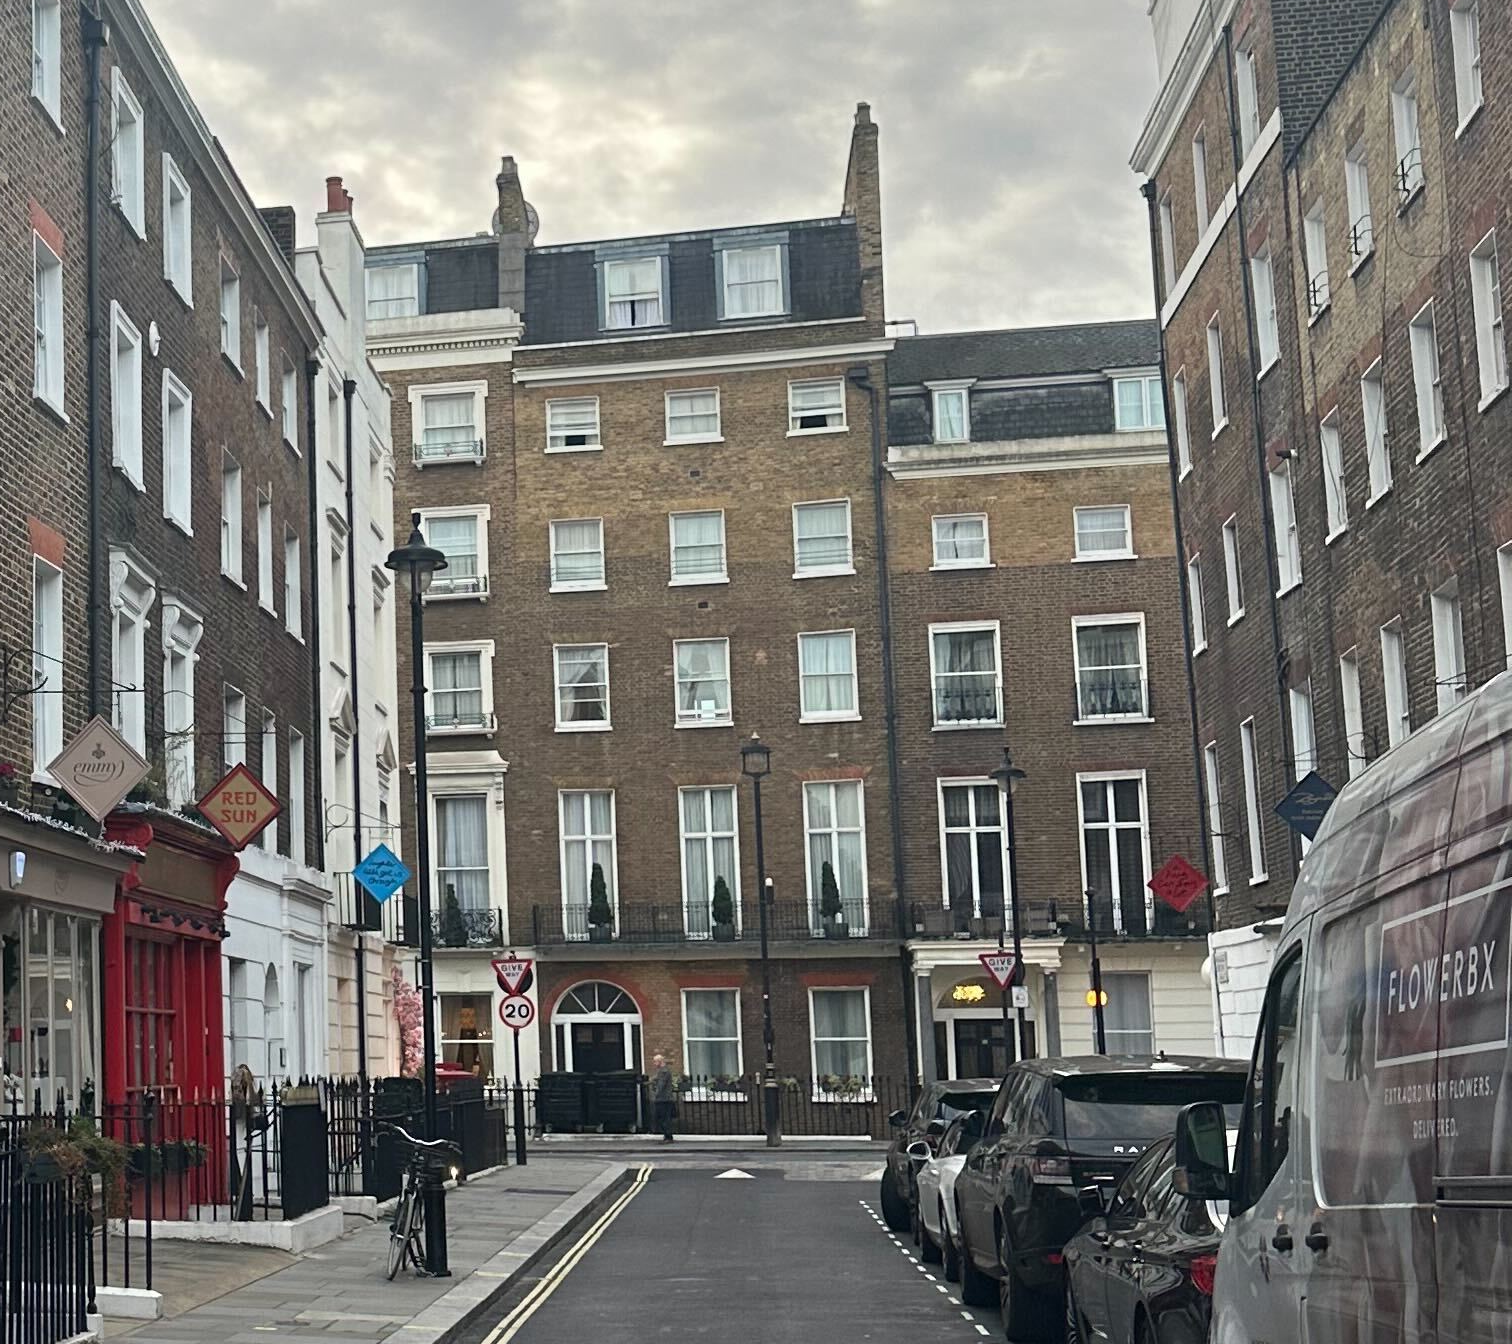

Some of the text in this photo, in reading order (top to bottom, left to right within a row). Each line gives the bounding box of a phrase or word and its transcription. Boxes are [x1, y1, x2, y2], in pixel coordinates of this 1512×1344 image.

[221, 792, 257, 805] RED
[221, 810, 257, 823] SUN
[501, 964, 523, 972] GIVE
[988, 958, 1013, 966] GIVE
[1388, 940, 1496, 1016] FLOWERBX
[505, 1003, 530, 1018] 20
[1384, 1081, 1447, 1105] EXTRAORDINARY
[1449, 1076, 1494, 1099] FLOWERS.
